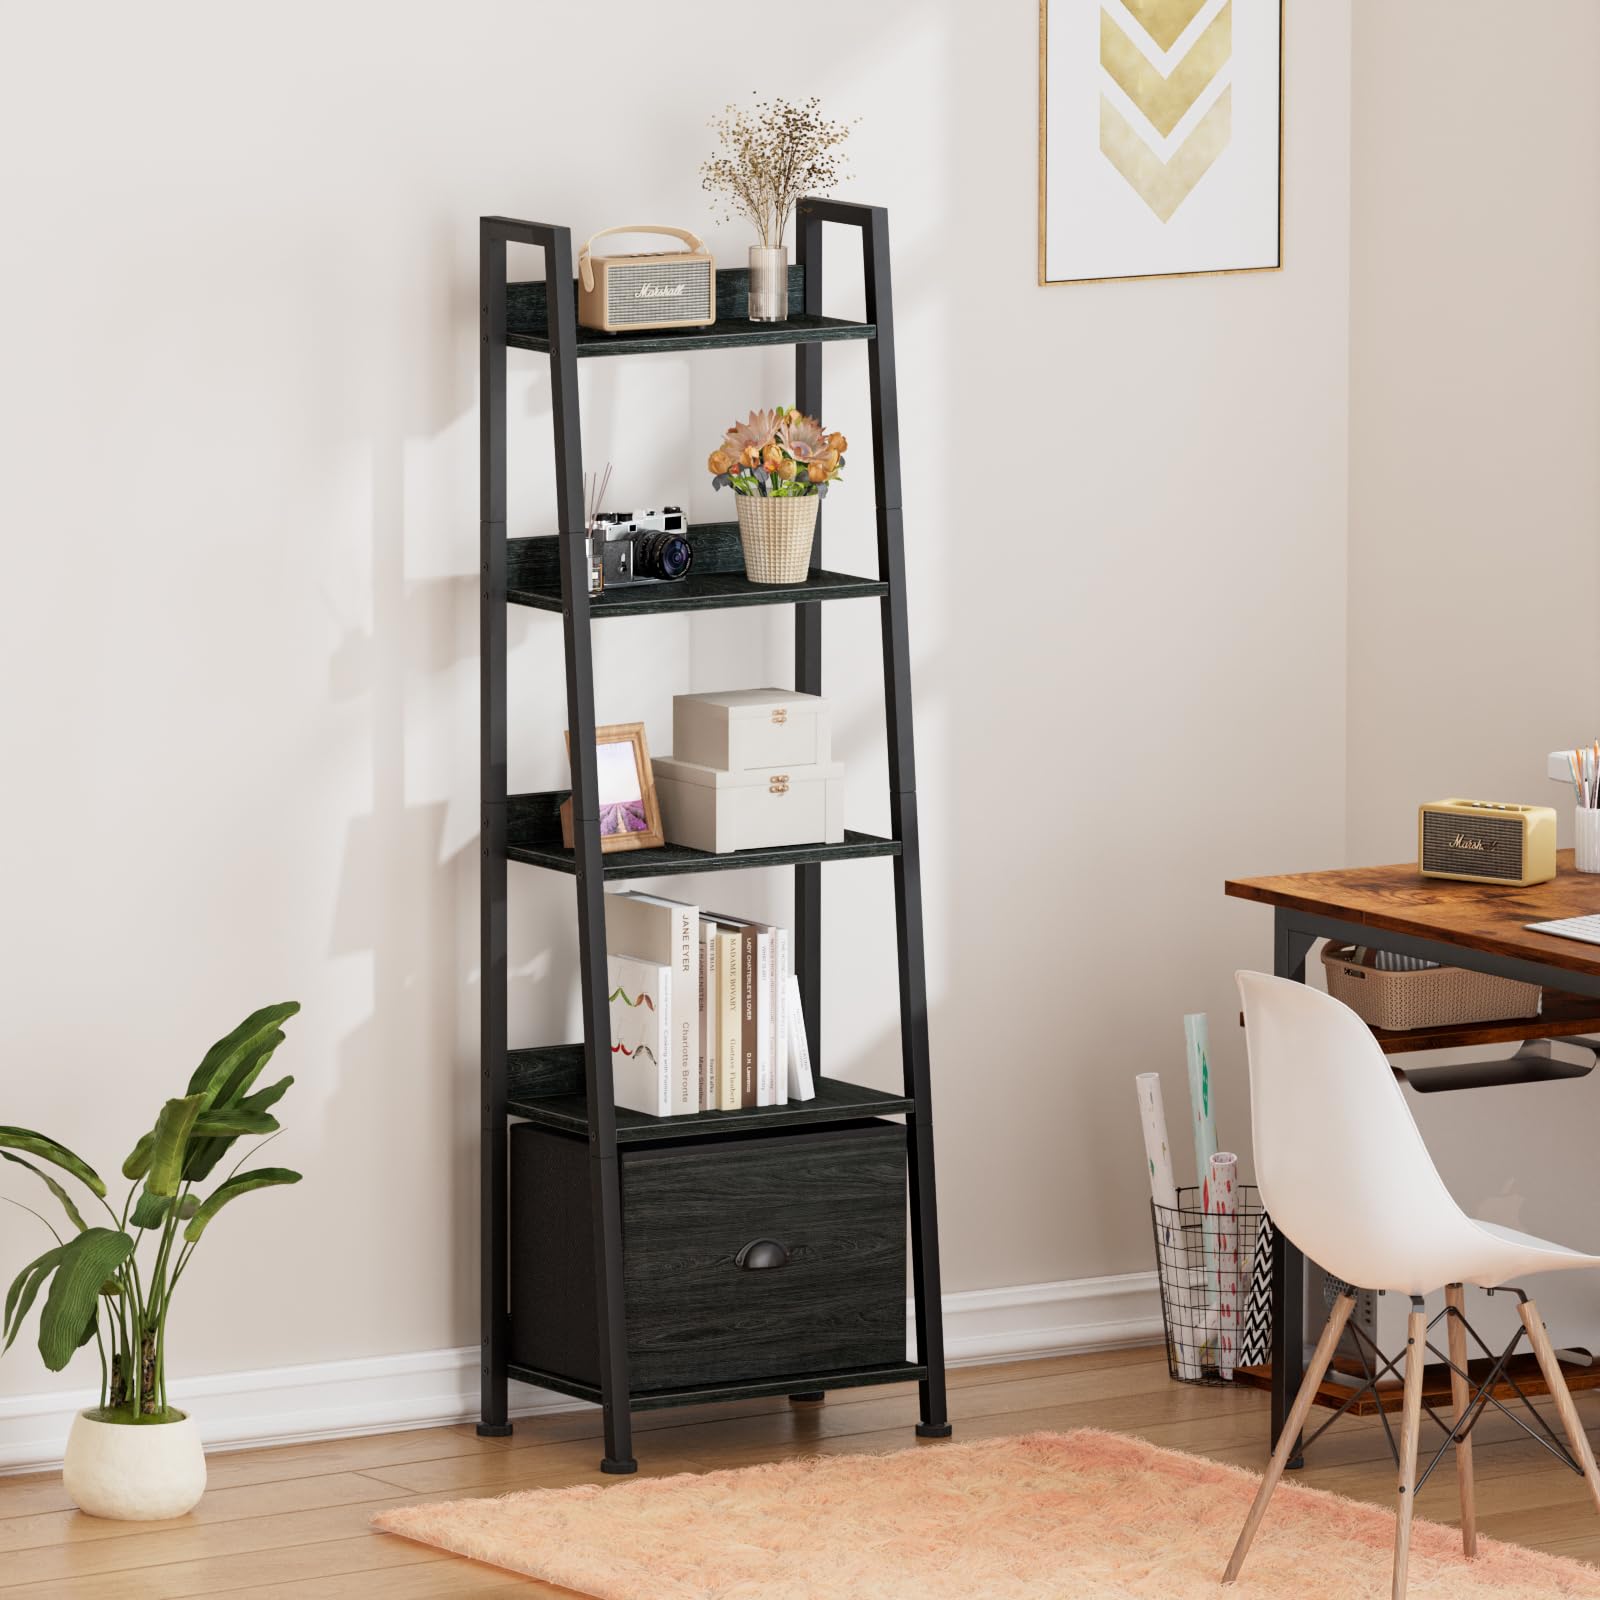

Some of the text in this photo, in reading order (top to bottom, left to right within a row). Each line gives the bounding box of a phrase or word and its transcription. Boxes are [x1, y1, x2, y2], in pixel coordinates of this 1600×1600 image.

[634, 283, 686, 298] Marshall
[682, 914, 690, 972] JANE EYER
[729, 938, 737, 1011] MADAME BOVARY
[682, 1022, 690, 1067] Charlotte
[729, 1038, 737, 1104] Gustave Flaubert
